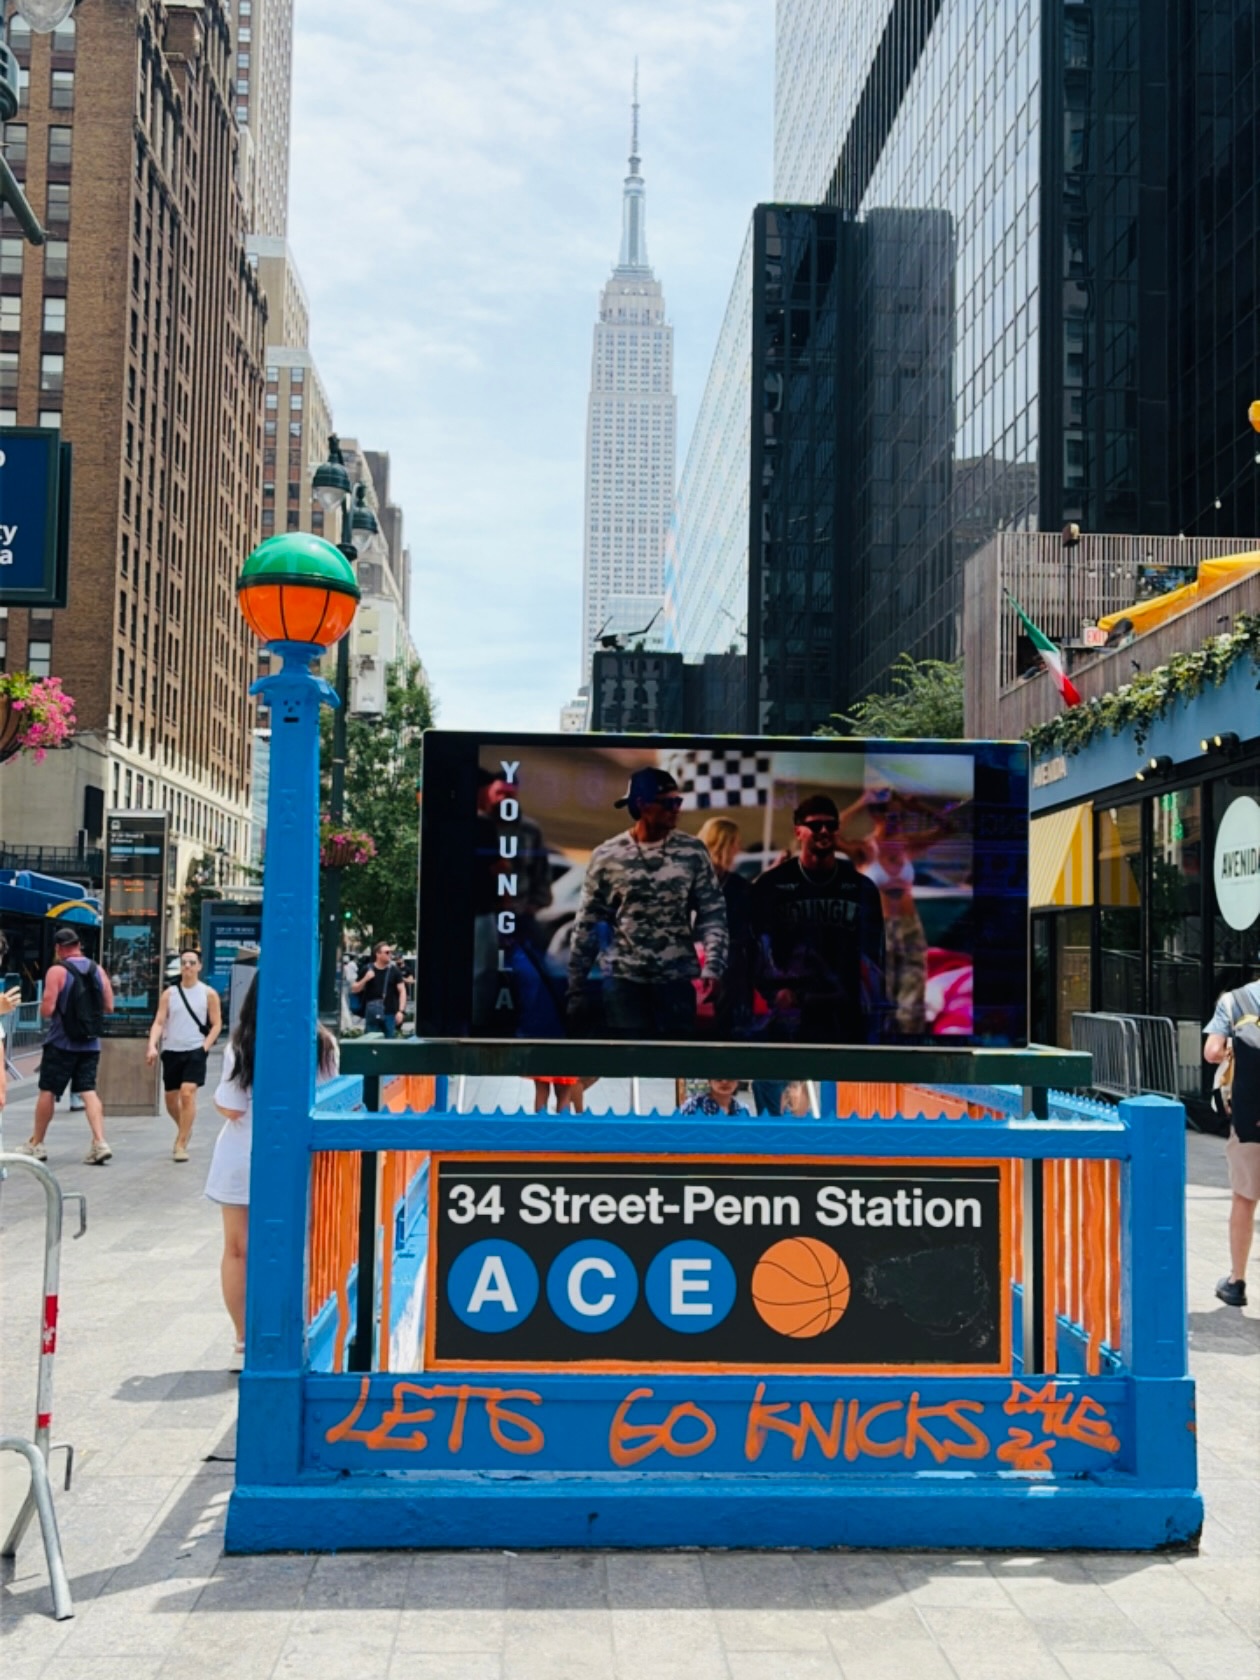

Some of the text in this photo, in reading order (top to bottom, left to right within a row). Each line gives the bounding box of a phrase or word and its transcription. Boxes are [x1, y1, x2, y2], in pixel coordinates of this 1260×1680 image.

[495, 760, 521, 1010] YOUNGLA
[448, 1183, 982, 1228] 34 Street-Penn Station
[467, 1255, 713, 1316] A C E
[325, 1377, 990, 1467] LETS GO KNICKS
